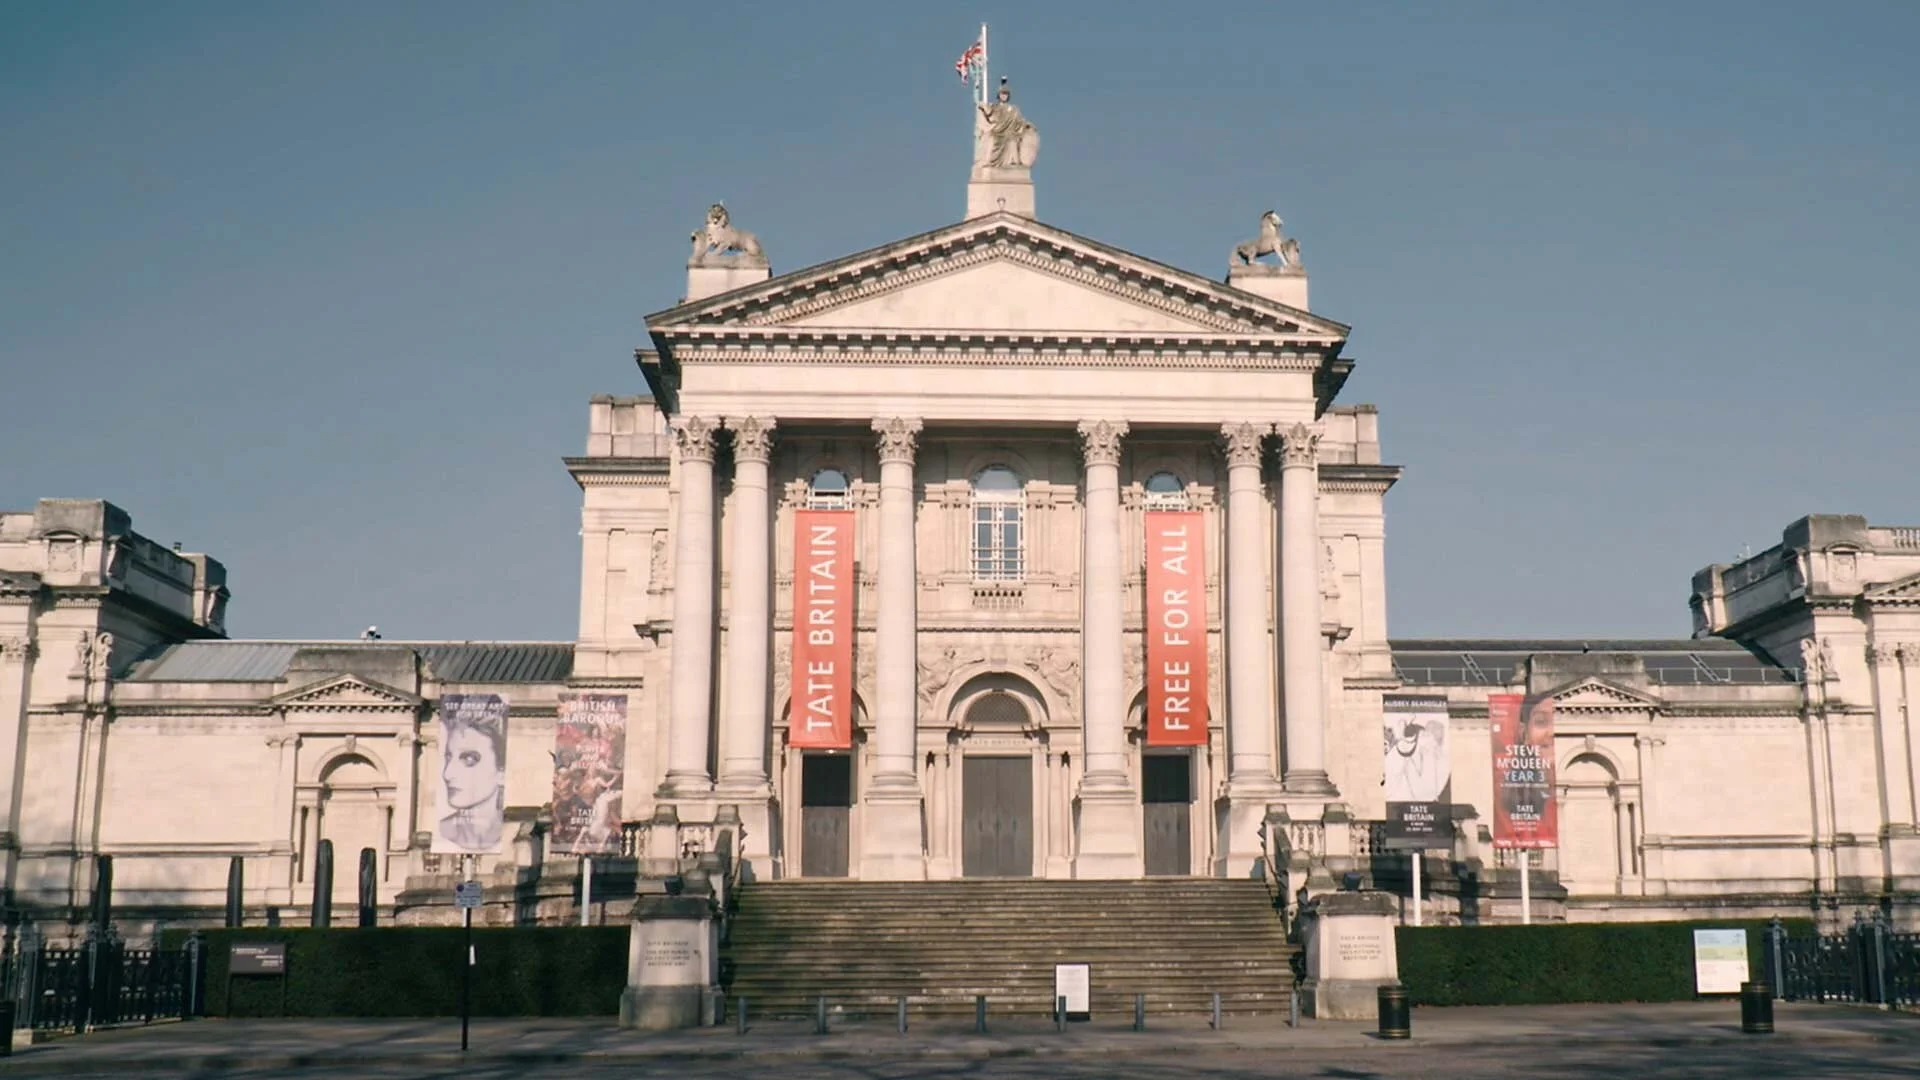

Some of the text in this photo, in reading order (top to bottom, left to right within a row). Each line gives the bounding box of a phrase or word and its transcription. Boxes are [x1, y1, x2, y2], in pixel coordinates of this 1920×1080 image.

[807, 525, 837, 732] TATE BRITAIN
[1161, 524, 1190, 730] FREE FOR ALL
[1505, 744, 1540, 757] STEVE
[1504, 770, 1545, 782] YEAR 3
[1410, 805, 1428, 814] TATE
[1516, 804, 1534, 813] TATE
[1403, 813, 1434, 821] BRITAIN
[1510, 813, 1541, 821] BRITAIN
